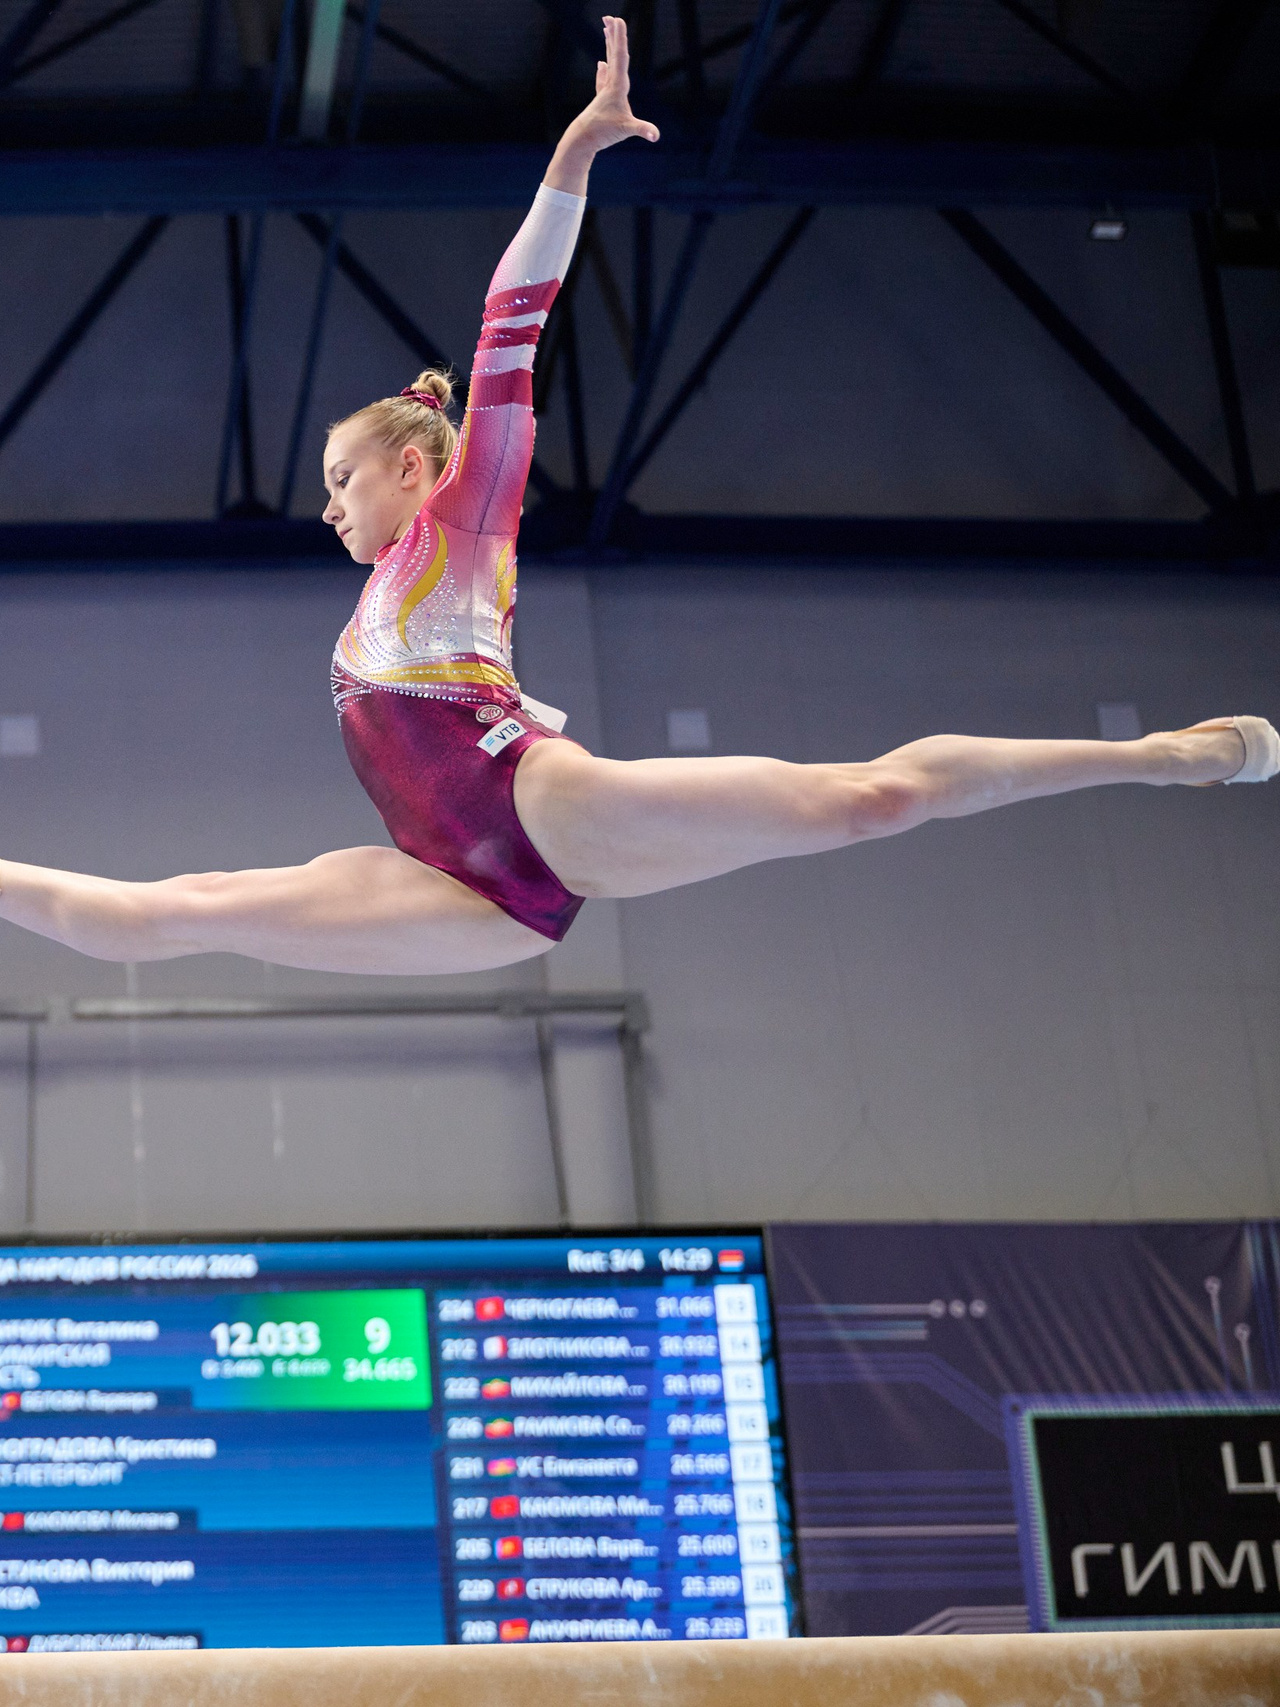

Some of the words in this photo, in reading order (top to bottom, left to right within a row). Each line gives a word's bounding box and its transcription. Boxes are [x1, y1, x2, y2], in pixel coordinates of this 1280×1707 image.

[495, 723, 520, 740] VTB
[210, 1321, 321, 1357] 12.033
[364, 1317, 392, 1355] 9
[343, 1357, 418, 1382] 34.665
